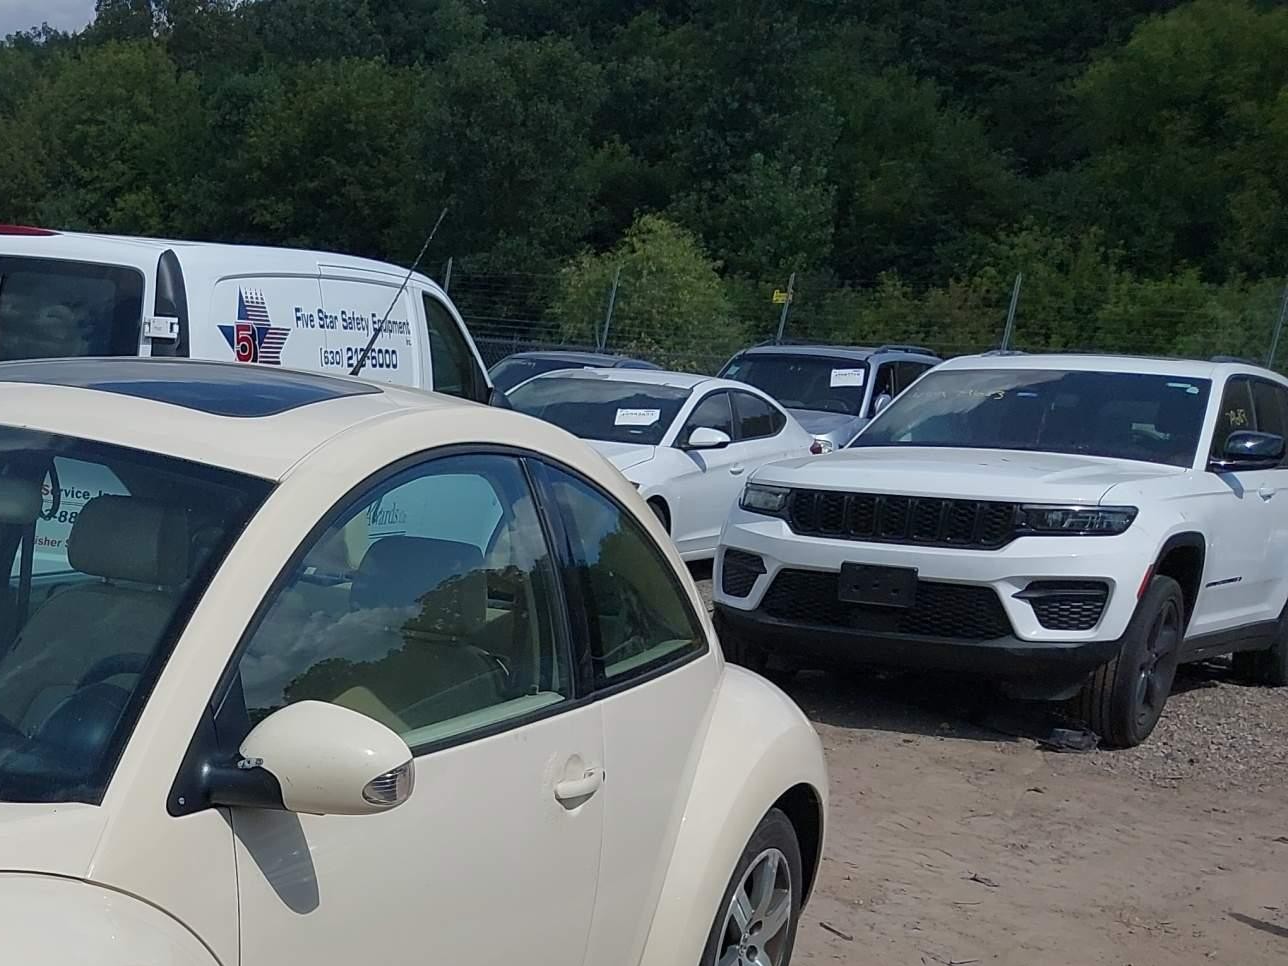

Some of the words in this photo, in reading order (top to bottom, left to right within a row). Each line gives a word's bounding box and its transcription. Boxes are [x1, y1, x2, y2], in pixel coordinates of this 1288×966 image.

[294, 306, 316, 329] Five
[317, 308, 339, 330] Star
[340, 310, 370, 337] Safety
[371, 312, 411, 339] Equipment
[319, 347, 344, 367] (630)
